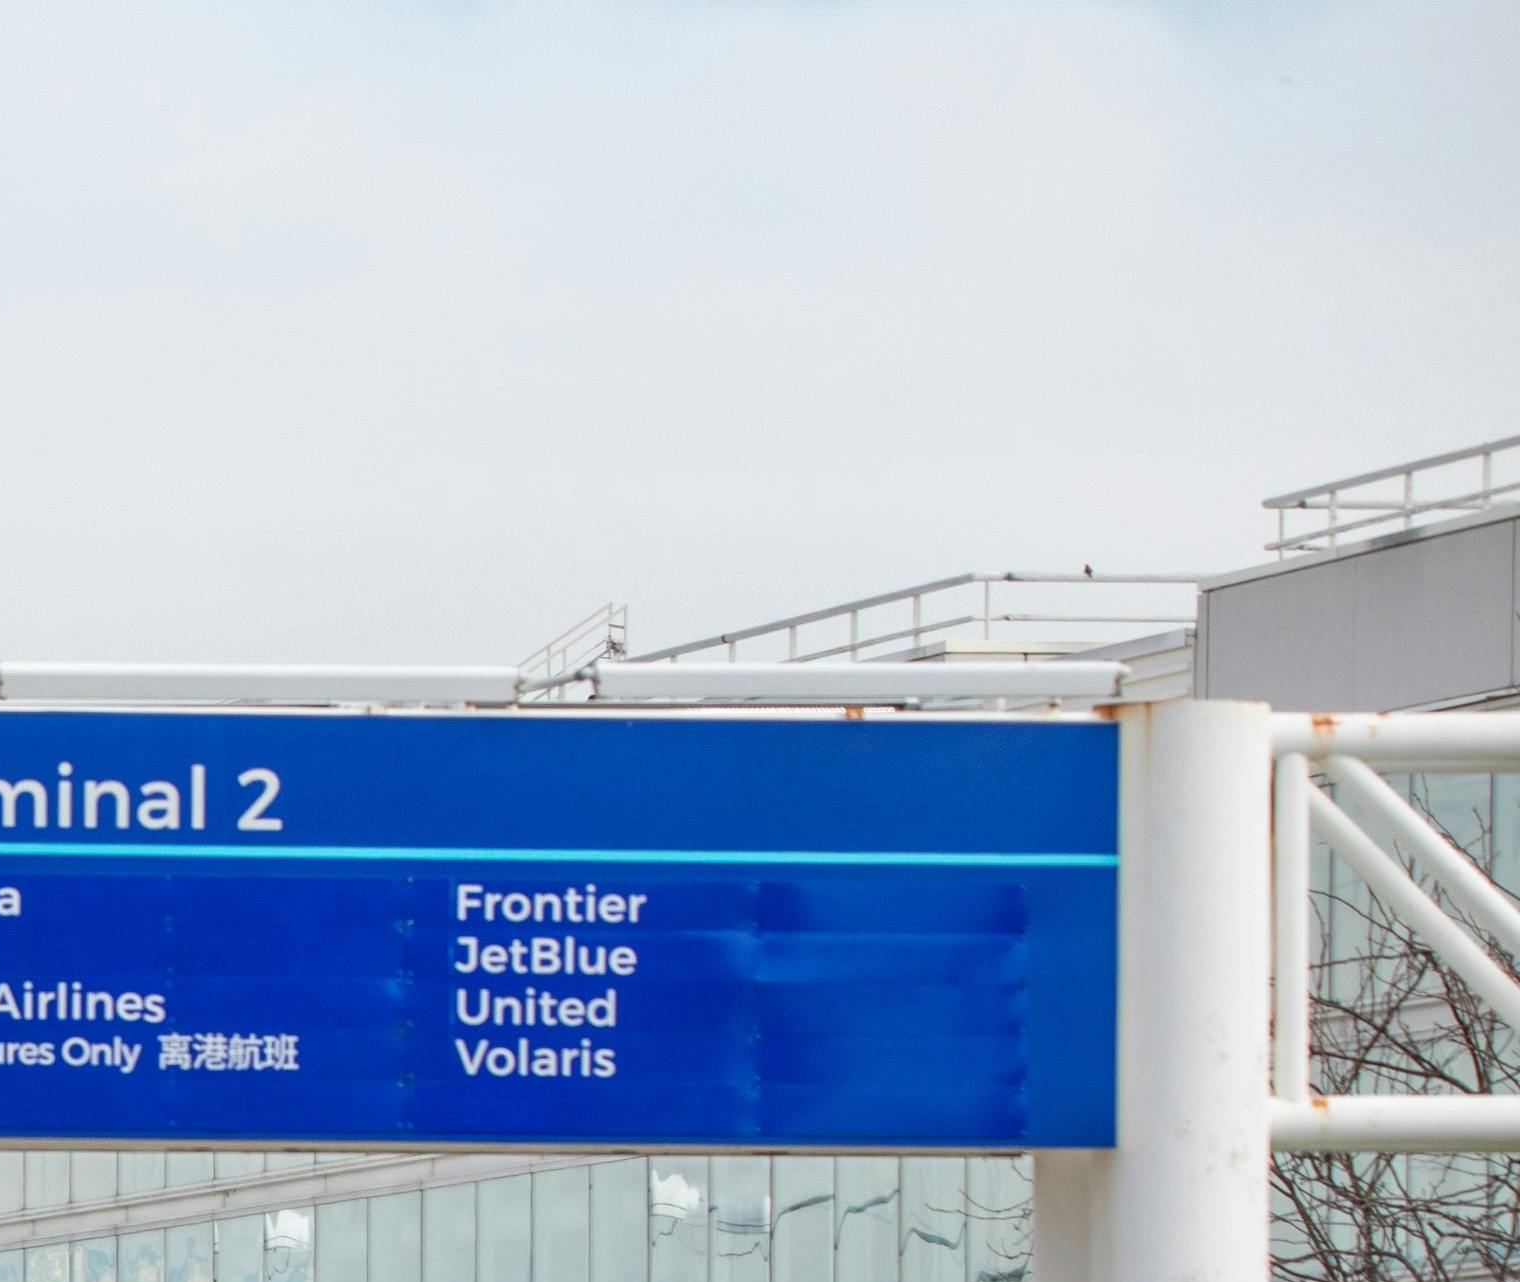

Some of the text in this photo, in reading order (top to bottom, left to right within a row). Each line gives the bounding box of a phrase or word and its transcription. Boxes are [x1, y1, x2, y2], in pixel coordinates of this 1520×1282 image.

[237, 767, 283, 831] 2
[457, 884, 647, 923] Frontier
[455, 936, 637, 976] JetBlue
[457, 987, 617, 1027] United
[62, 1036, 142, 1073] Only
[158, 1032, 300, 1071] 离港航班
[455, 1038, 616, 1077] Volaris
